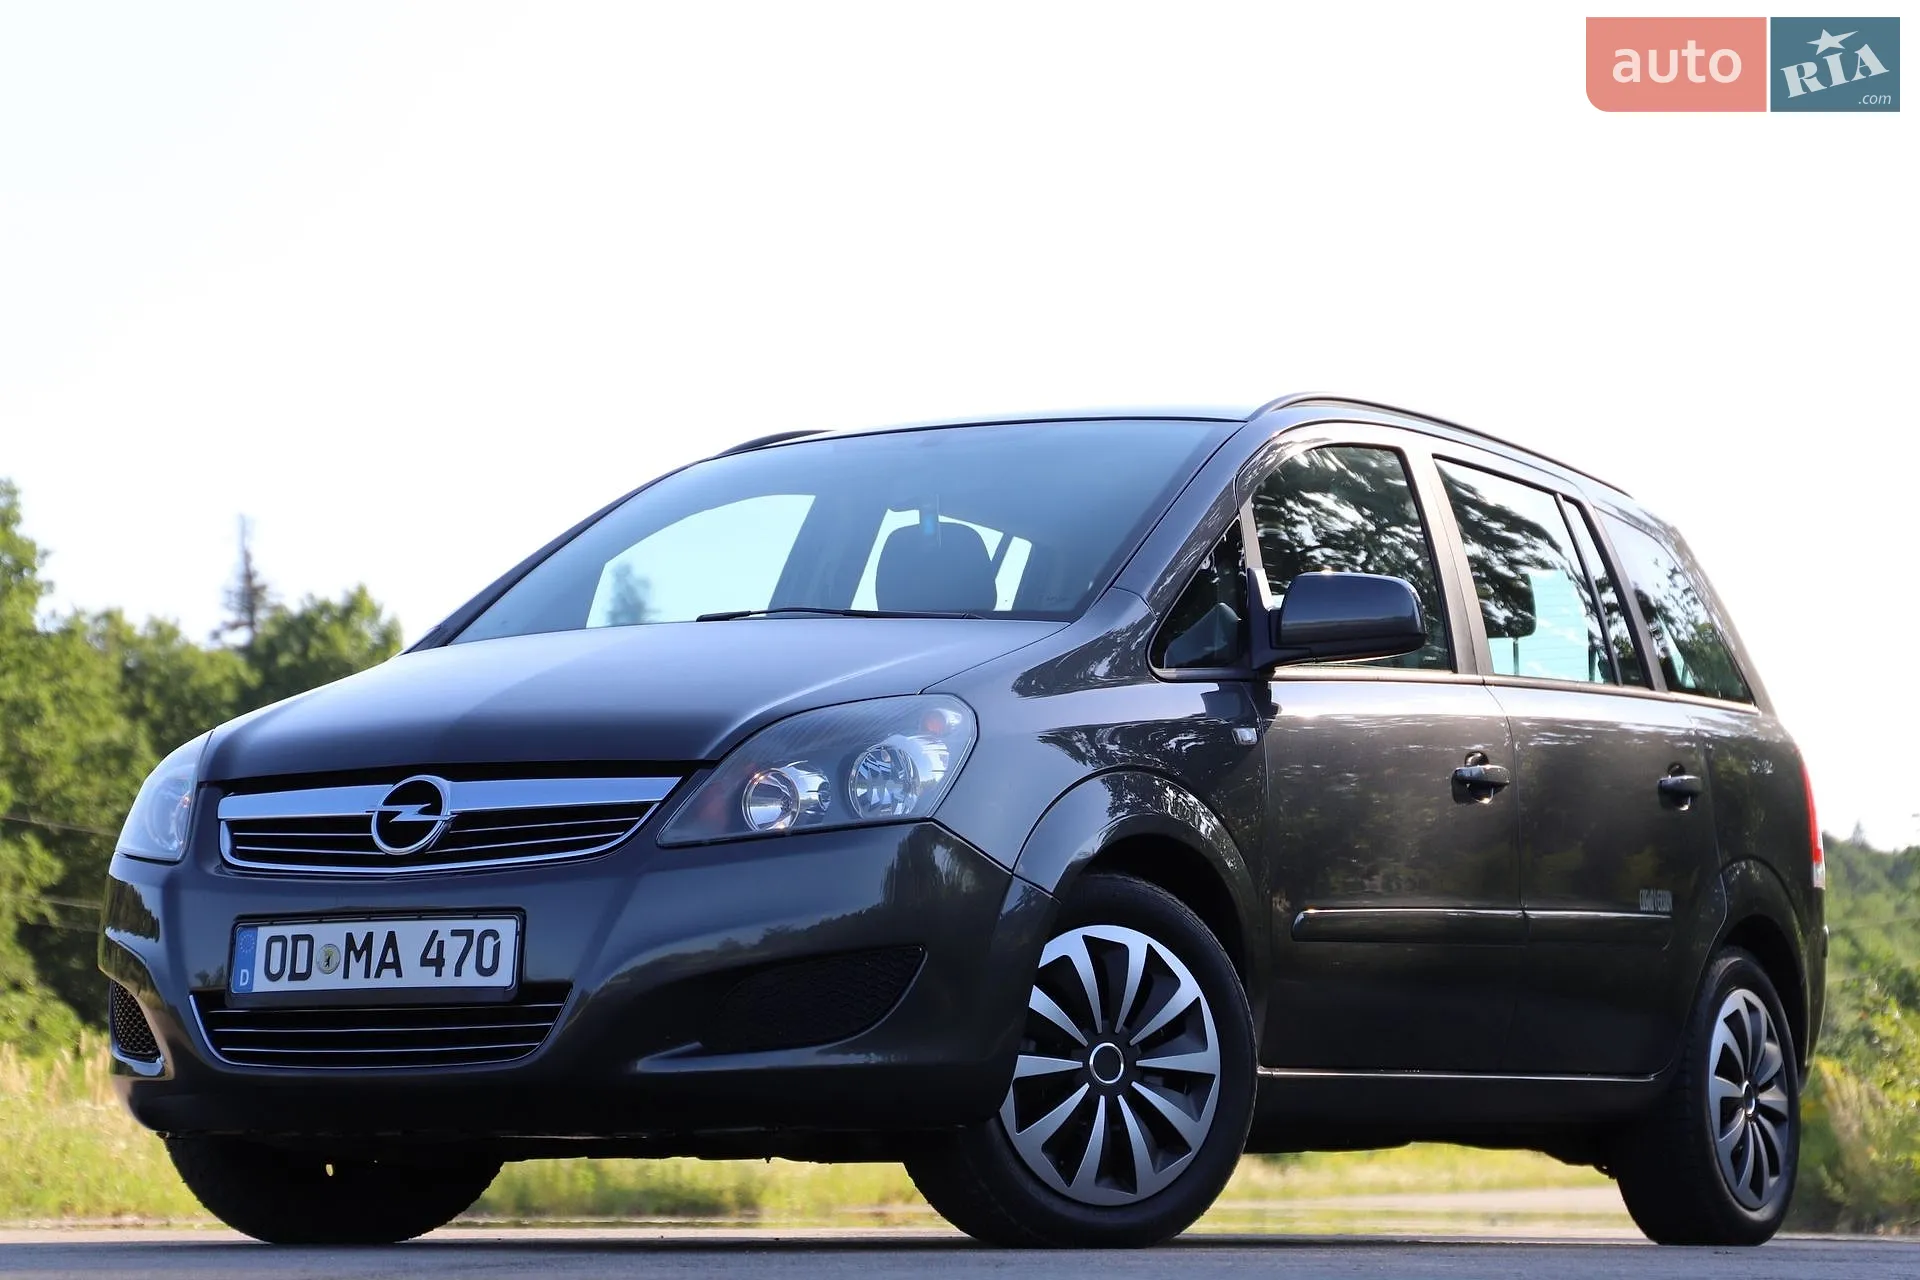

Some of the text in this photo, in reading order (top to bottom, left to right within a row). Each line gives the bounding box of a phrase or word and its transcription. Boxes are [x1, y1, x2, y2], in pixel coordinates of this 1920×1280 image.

[264, 929, 501, 982] OD MA 470
[239, 968, 250, 987] D
